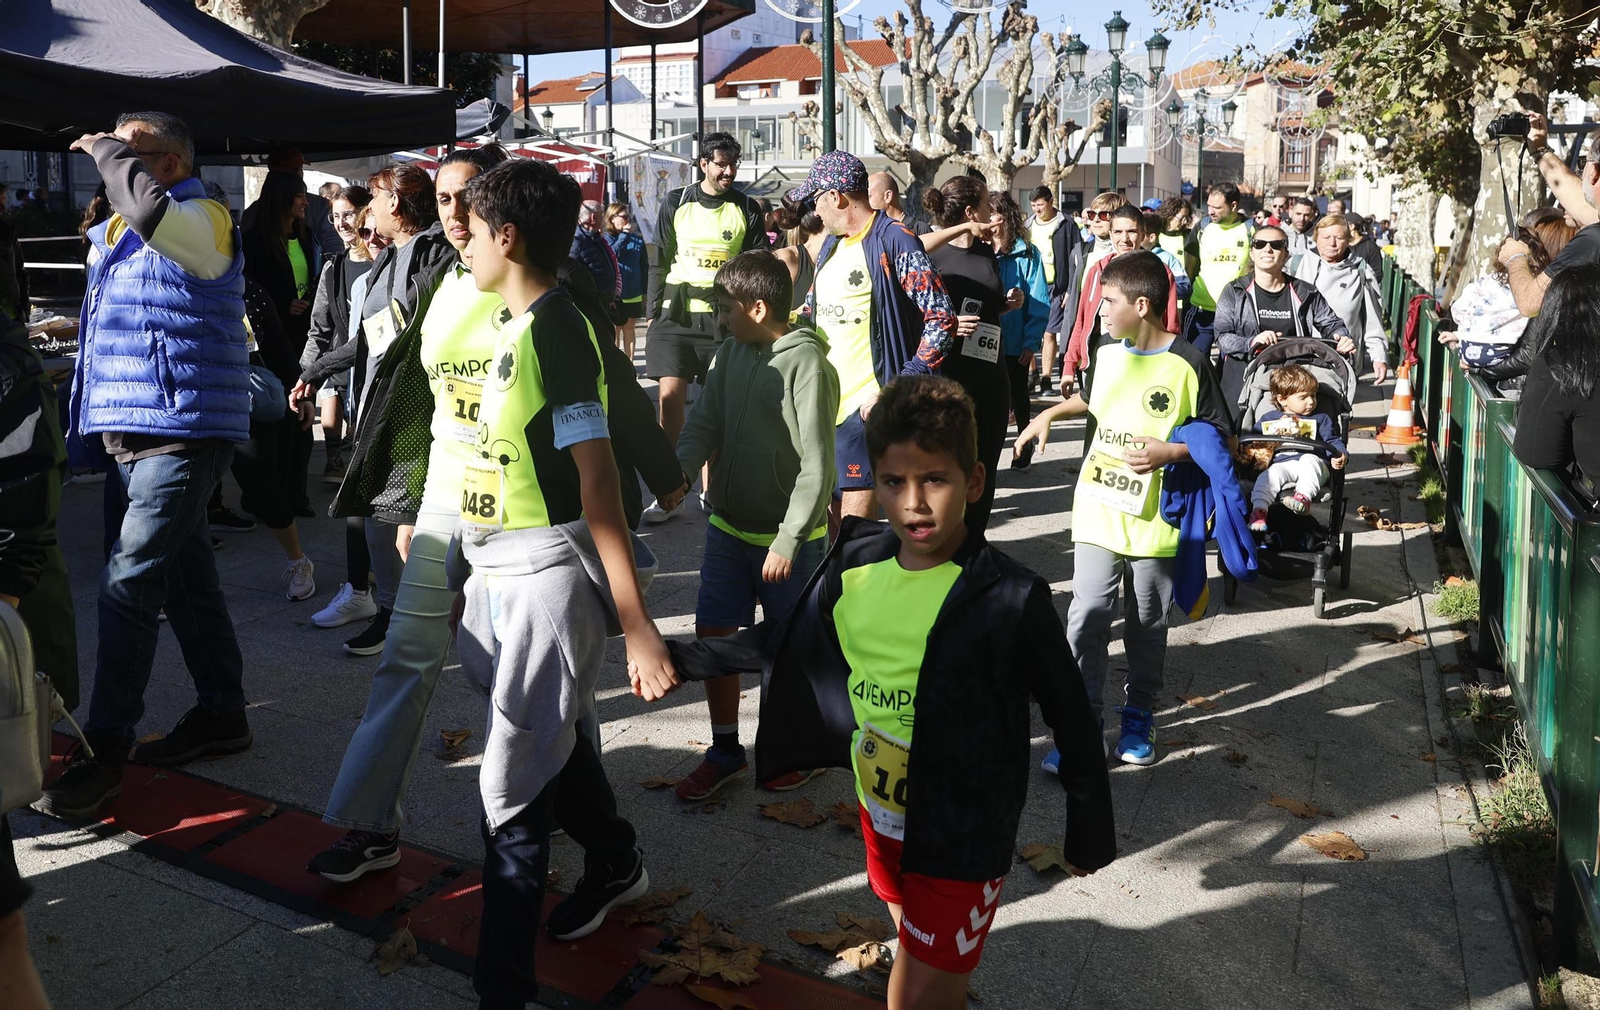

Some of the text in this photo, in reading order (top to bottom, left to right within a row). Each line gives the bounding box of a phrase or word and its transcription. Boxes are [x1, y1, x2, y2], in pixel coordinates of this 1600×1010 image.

[1092, 465, 1143, 497] 1390
[461, 488, 496, 518] 048
[852, 679, 917, 711] AVEMP
[901, 909, 936, 947] ummel
